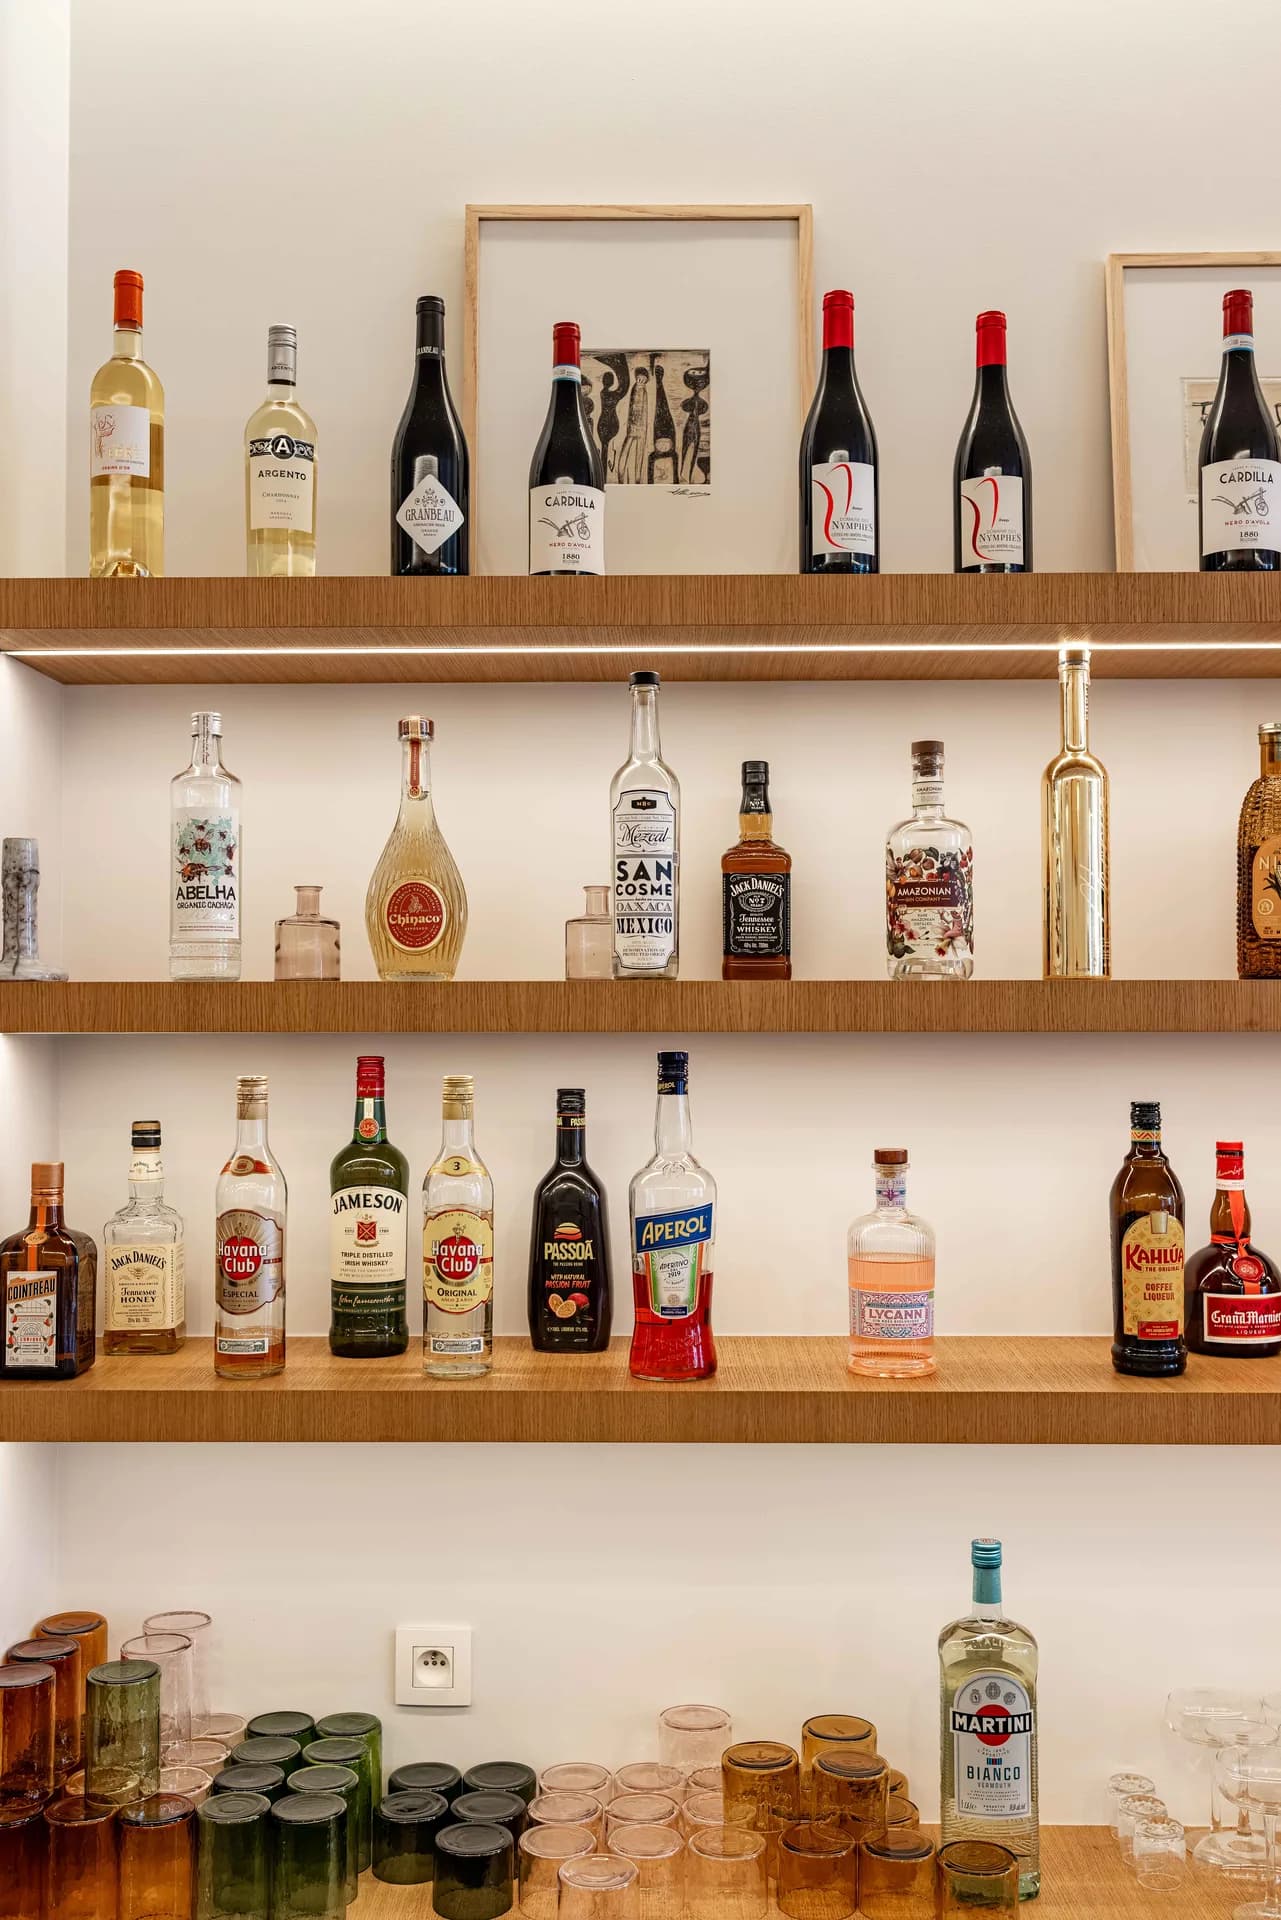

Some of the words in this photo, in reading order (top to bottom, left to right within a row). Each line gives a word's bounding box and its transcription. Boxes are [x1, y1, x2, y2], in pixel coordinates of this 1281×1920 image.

[276, 438, 291, 454] A
[257, 469, 307, 481] ARGENTO
[1219, 470, 1274, 484] CARDILLA
[545, 495, 595, 510] CARDILLA
[405, 507, 455, 523] GRANBEAU
[832, 519, 874, 532] NYMPHES
[979, 533, 1022, 543] NYMPHES
[1239, 530, 1259, 538] 1880
[562, 552, 580, 560] 1880
[617, 823, 669, 848] Mezcal
[616, 860, 672, 882] SAN
[176, 885, 236, 901] ABELHA
[616, 883, 673, 896] COSME
[730, 880, 752, 897] JACK
[751, 877, 785, 898] DANIEL'S
[897, 886, 952, 897] AMAZONIAN
[177, 901, 207, 909] ORGANIC
[616, 902, 672, 912] OAXACA
[389, 913, 440, 927] Chinaco
[739, 913, 775, 923] Tennessee
[616, 917, 673, 934] MEXICO
[453, 1161, 461, 1171] 3
[333, 1192, 403, 1215] JAMESON
[641, 1215, 707, 1247] APEROL
[218, 1240, 270, 1257] Havana
[362, 1251, 394, 1259] DISTILLED
[432, 1240, 483, 1257] Havana
[543, 1239, 594, 1261] PASSOÃ
[111, 1253, 132, 1271] JACK
[133, 1250, 167, 1270] DANIEL'S
[1124, 1243, 1184, 1272] KAHLÚA
[224, 1257, 256, 1274] Club
[440, 1256, 473, 1273] Club
[659, 1258, 689, 1271] APERITIVO
[550, 1273, 564, 1281] WITH
[563, 1273, 586, 1281] NATURAL
[668, 1271, 682, 1280] 1919
[7, 1278, 56, 1301] COINTREAU
[545, 1280, 571, 1289] PASSION
[571, 1279, 592, 1289] FRUIT
[1145, 1282, 1174, 1292] COFFEE
[120, 1287, 157, 1296] Tennessee
[223, 1288, 259, 1298] ESPECIAL
[436, 1287, 478, 1298] ORIGINAL
[1143, 1292, 1175, 1302] LIQUEUR
[120, 1296, 156, 1304] HONEY
[869, 1308, 922, 1320] LYCANN
[1210, 1309, 1246, 1325] Grand
[1245, 1309, 1281, 1326] Marnier
[955, 1713, 1031, 1733] MARTINI
[967, 1765, 1021, 1781] BIANCO
